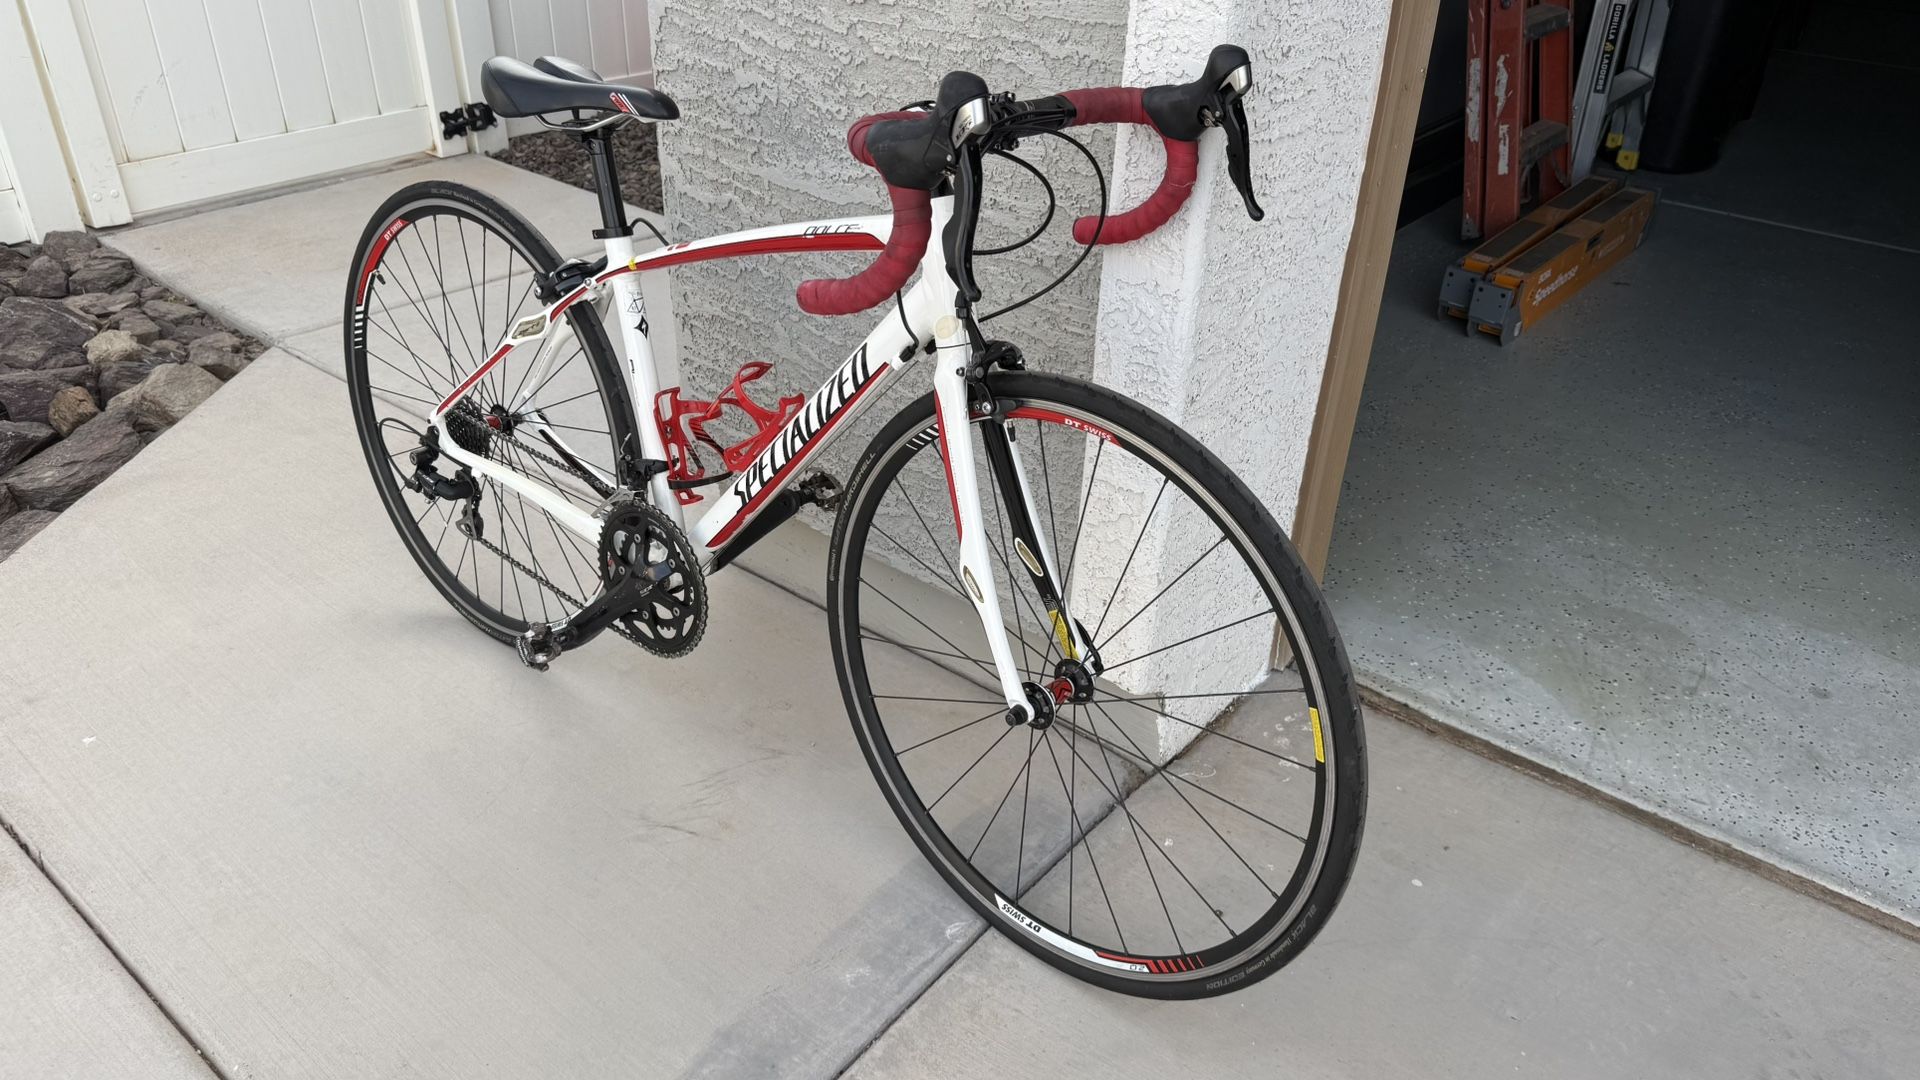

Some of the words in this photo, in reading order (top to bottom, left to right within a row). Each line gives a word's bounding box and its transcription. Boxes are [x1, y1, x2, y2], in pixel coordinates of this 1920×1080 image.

[1607, 5, 1622, 40] GORILLA
[1596, 54, 1611, 91] LADDERS
[734, 342, 870, 514] SPECIALIZED
[1064, 418, 1081, 428] DT
[1083, 424, 1112, 441] SWISS
[843, 452, 876, 512] HARDSHELL
[1001, 903, 1027, 924] SWISS
[1026, 920, 1042, 934] DT
[1291, 904, 1318, 941] BLACK
[1206, 971, 1246, 992] EDITION
